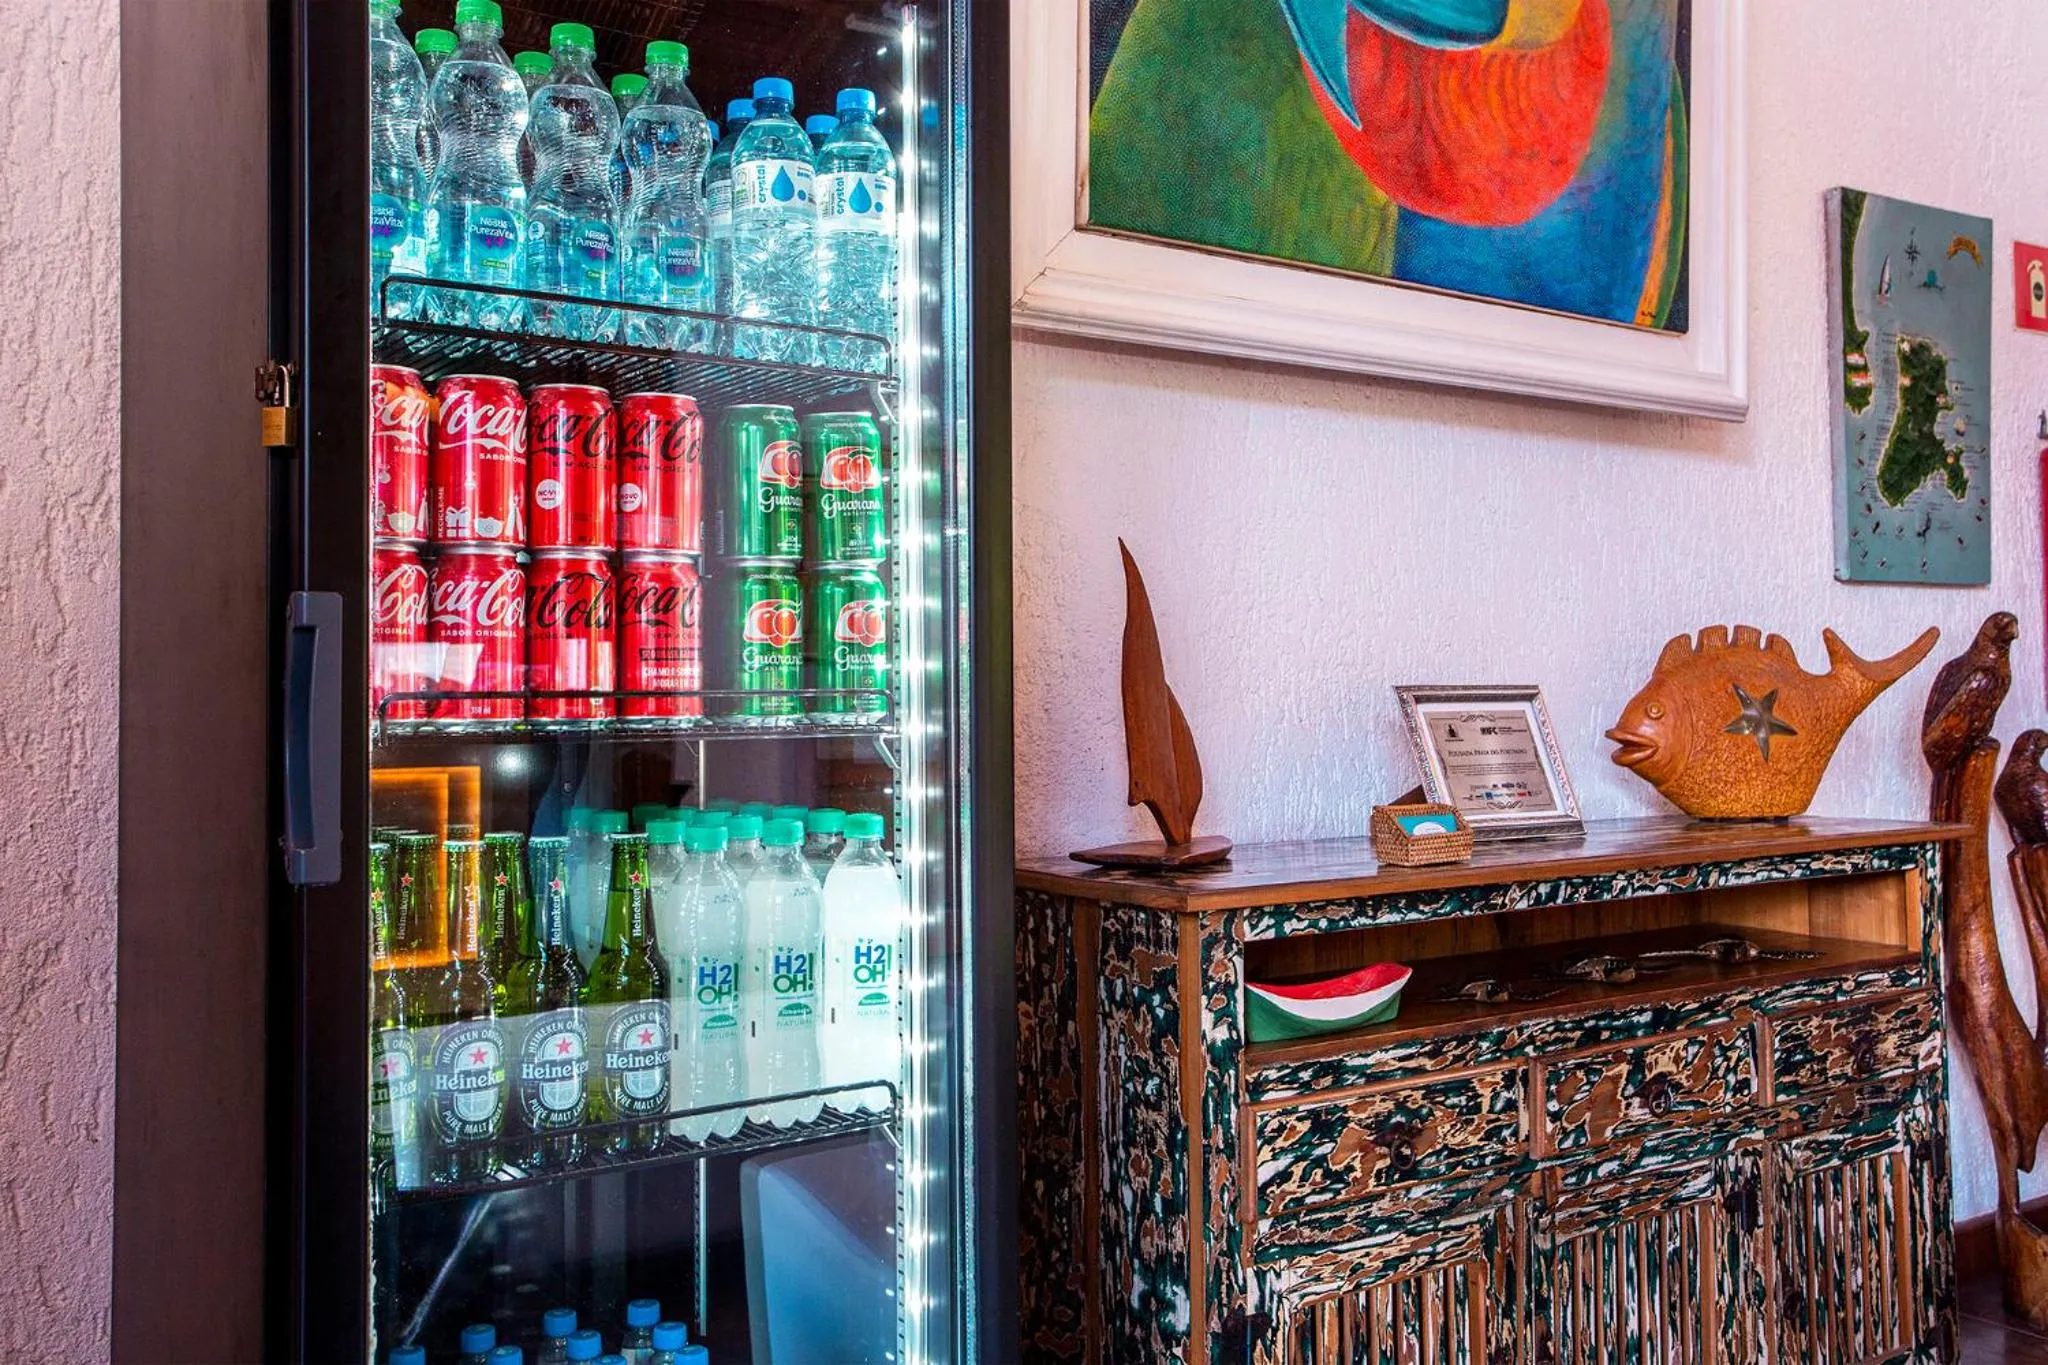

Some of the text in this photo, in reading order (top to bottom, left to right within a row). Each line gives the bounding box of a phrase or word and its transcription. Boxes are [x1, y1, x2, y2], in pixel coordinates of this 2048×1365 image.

[756, 165, 768, 203] crystal
[836, 177, 847, 214] crystal
[467, 898, 478, 953] Heineken
[495, 889, 506, 938] Heineken
[551, 894, 563, 946] Heineken
[632, 888, 641, 937] Heineken
[775, 954, 807, 974] H2
[855, 945, 885, 965] H2
[699, 964, 732, 985] H2
[442, 1030, 479, 1064] HEINEKEN
[528, 1022, 564, 1053] HEINEKEN
[528, 1098, 547, 1119] PURE
[550, 1111, 573, 1122] MALT
[633, 1099, 654, 1110] MALT
[443, 1110, 462, 1130] PURE
[464, 1123, 487, 1134] MALT
